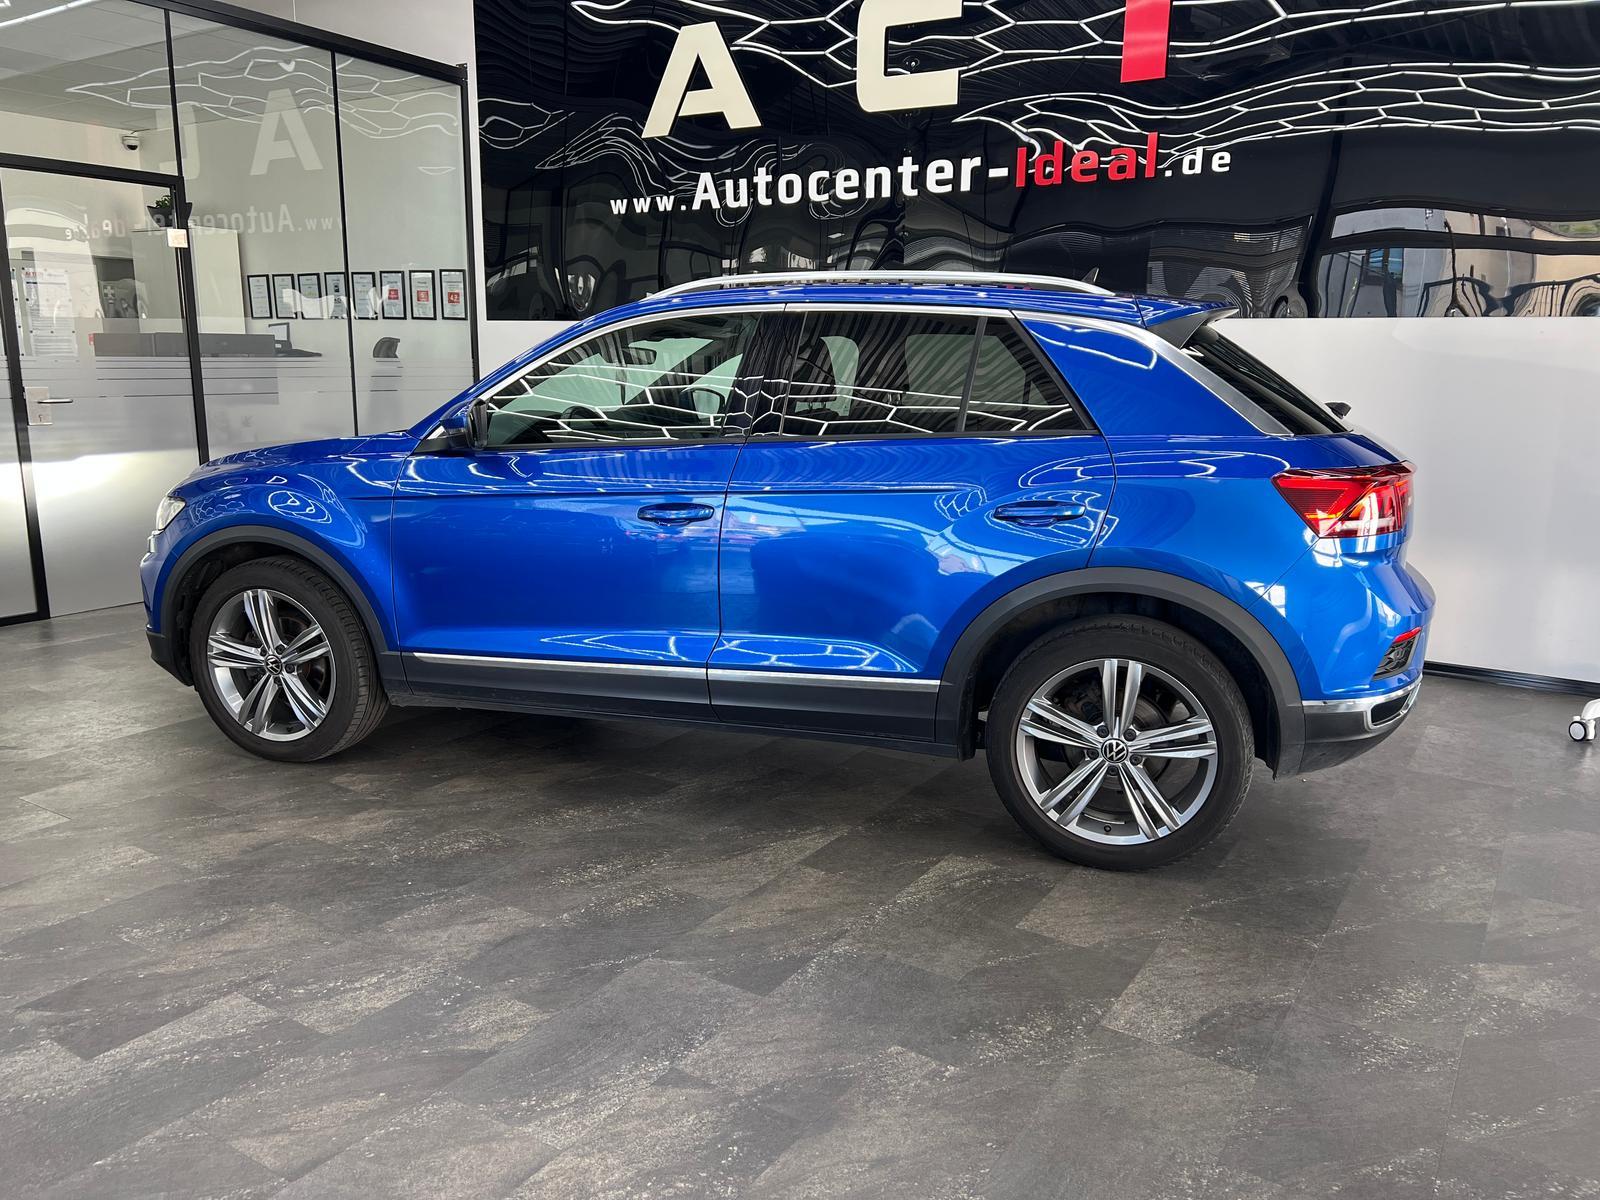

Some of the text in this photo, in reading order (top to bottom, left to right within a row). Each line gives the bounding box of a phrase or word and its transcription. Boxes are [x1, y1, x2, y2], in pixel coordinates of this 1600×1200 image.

[641, 21, 762, 138] A
[857, 0, 963, 112] C
[610, 132, 1232, 214] www.Autocenter-Ideal.de
